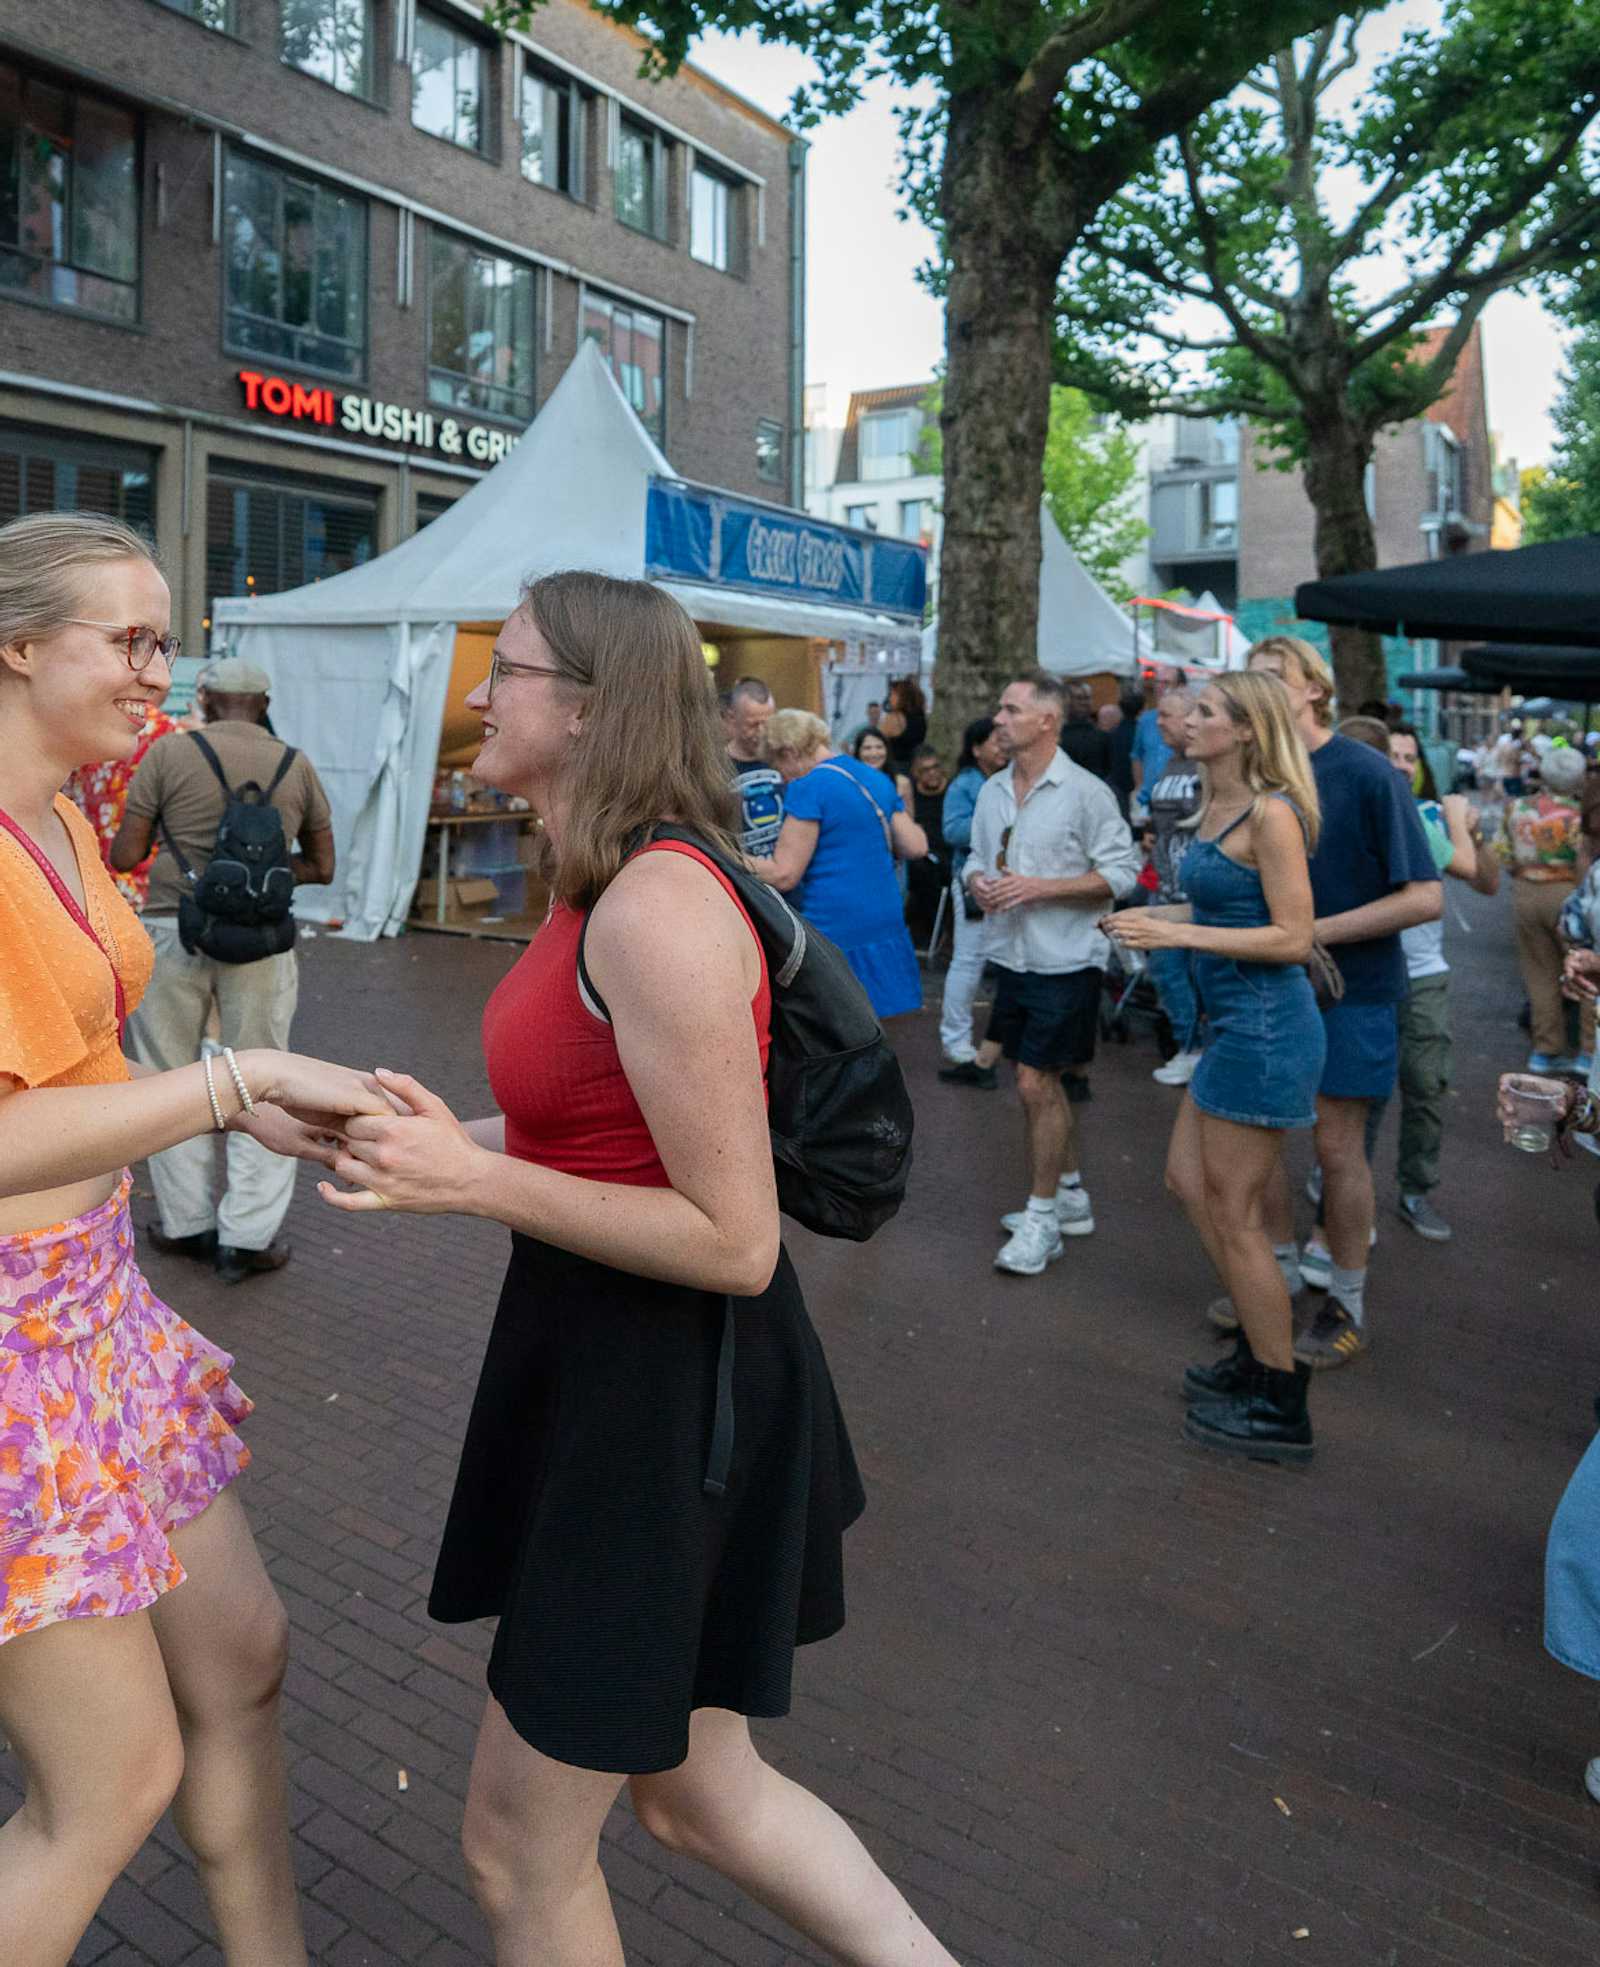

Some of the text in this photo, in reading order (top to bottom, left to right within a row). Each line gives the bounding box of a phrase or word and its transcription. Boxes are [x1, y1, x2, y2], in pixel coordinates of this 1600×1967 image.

[239, 371, 335, 426] TOMI
[341, 394, 434, 448] SUSHI
[439, 418, 463, 454] &
